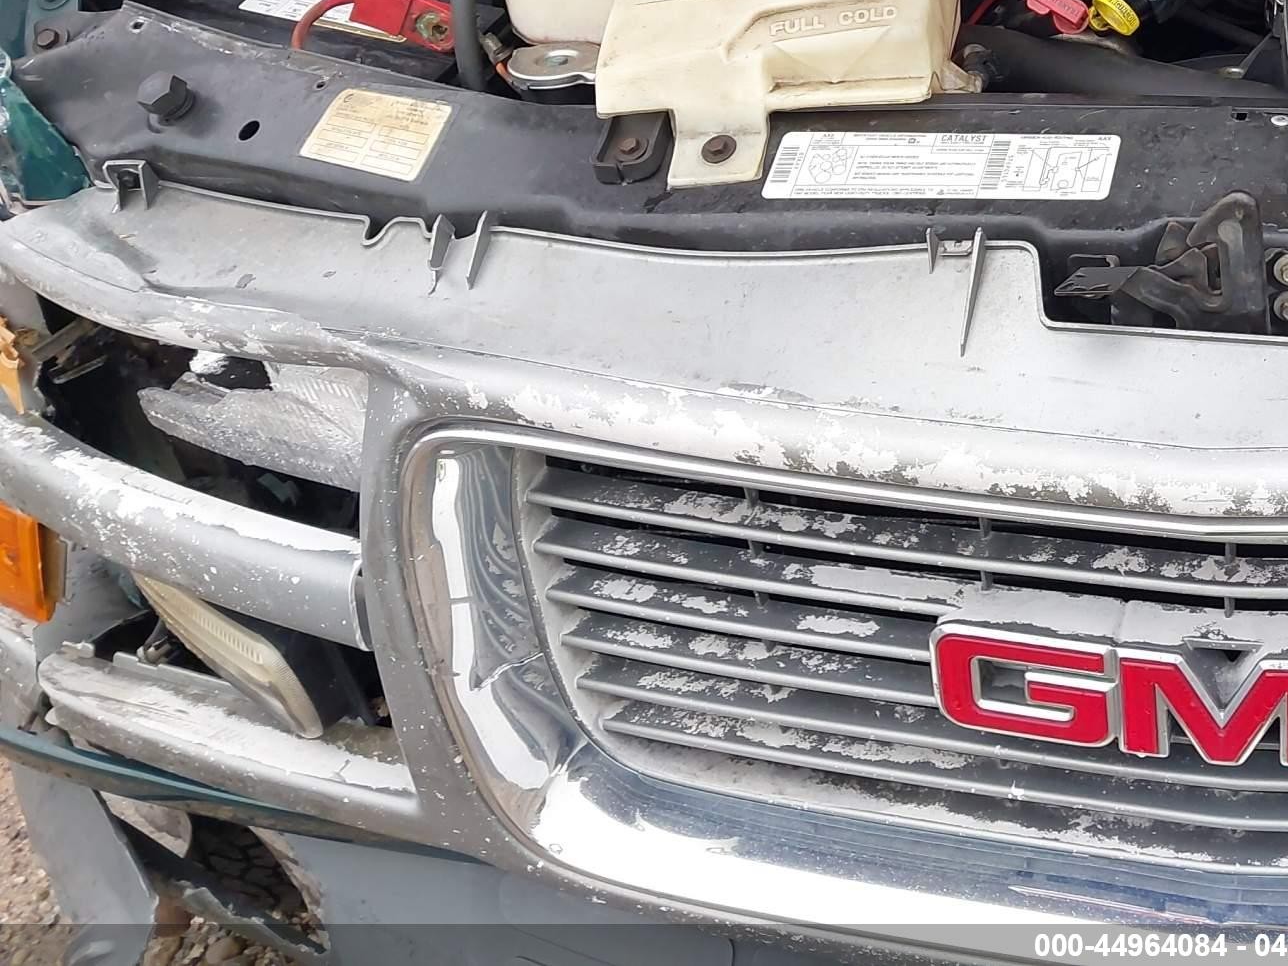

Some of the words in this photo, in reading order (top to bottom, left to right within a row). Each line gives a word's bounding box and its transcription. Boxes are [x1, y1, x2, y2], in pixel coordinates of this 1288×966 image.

[769, 16, 825, 36] FULL
[838, 6, 898, 25] COLD
[941, 134, 988, 142] CATALYST
